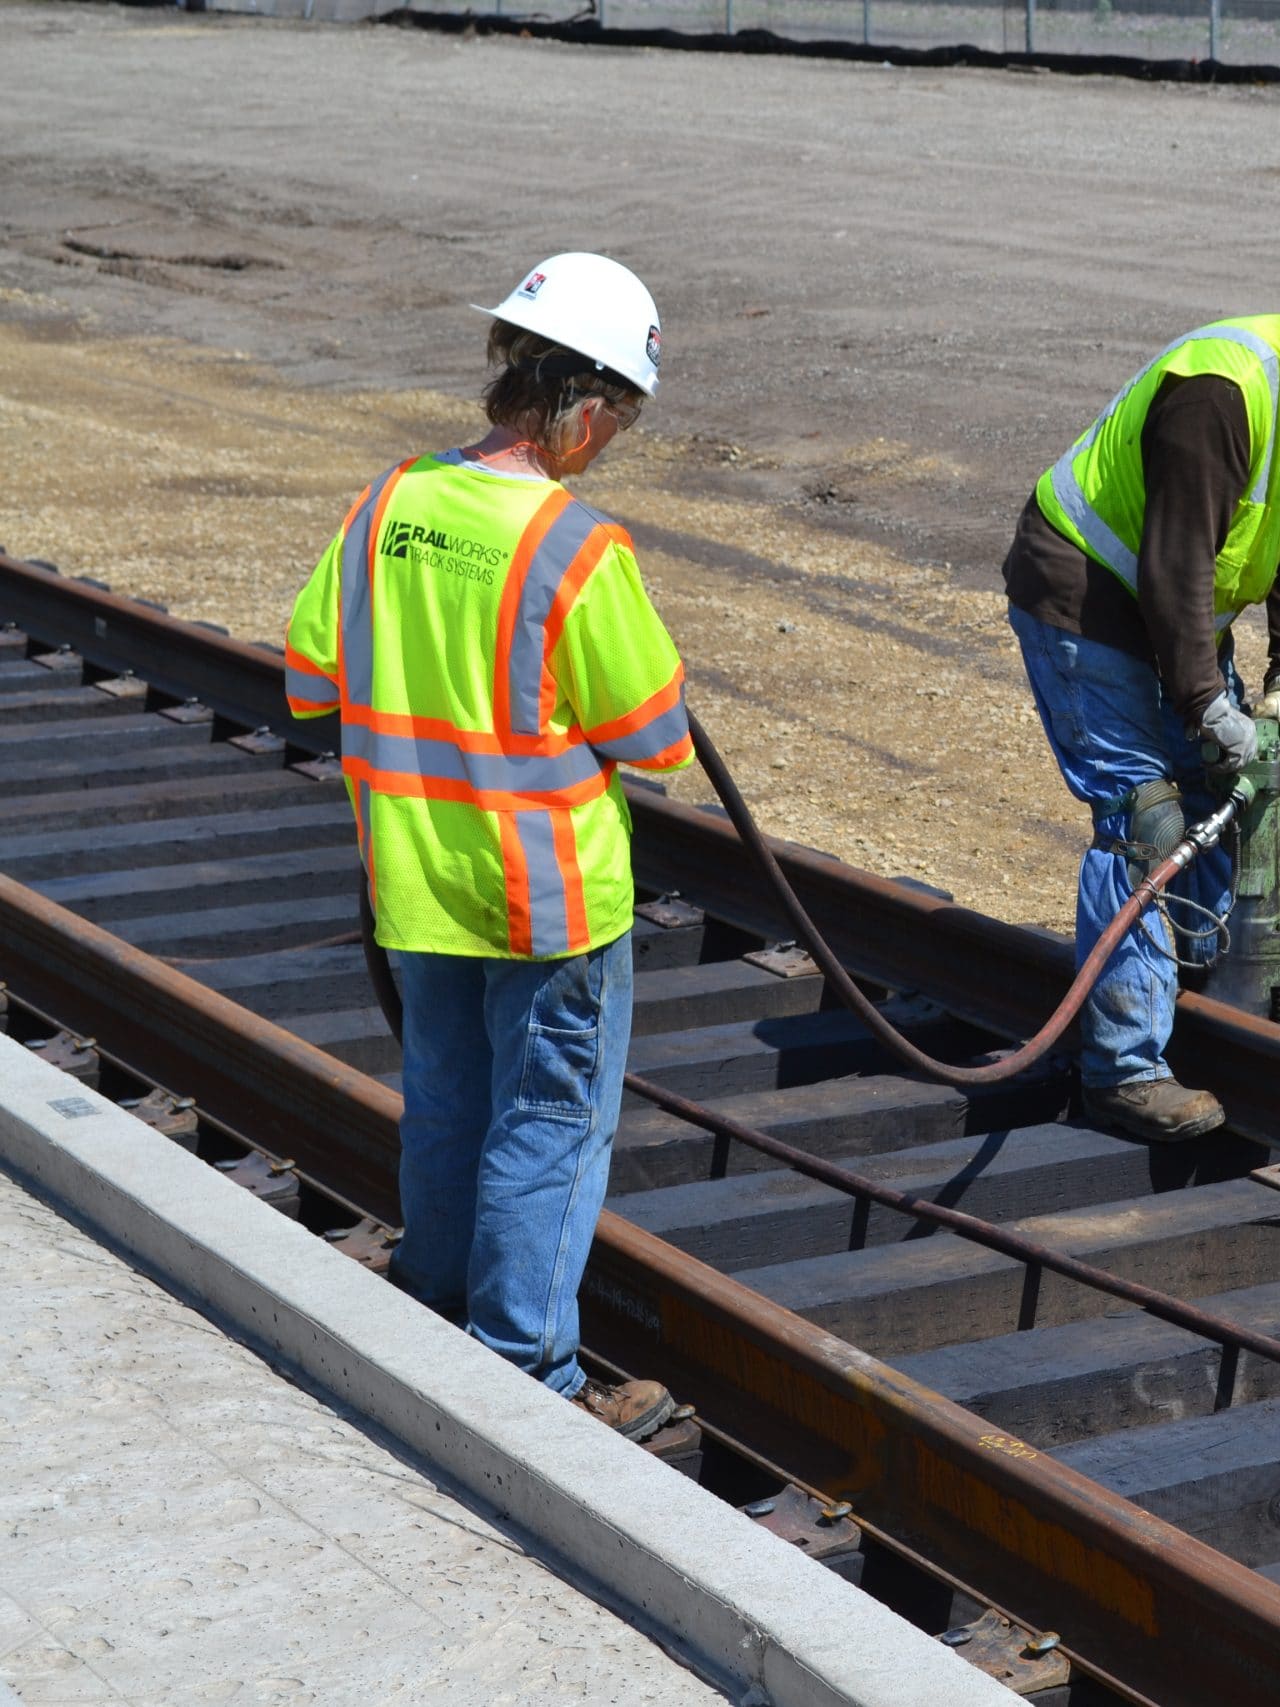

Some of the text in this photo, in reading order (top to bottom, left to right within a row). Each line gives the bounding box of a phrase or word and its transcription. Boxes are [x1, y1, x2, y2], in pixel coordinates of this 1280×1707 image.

[409, 544, 495, 586] TRACK SYSTEMS
[411, 525, 501, 566] RAILWORKS
